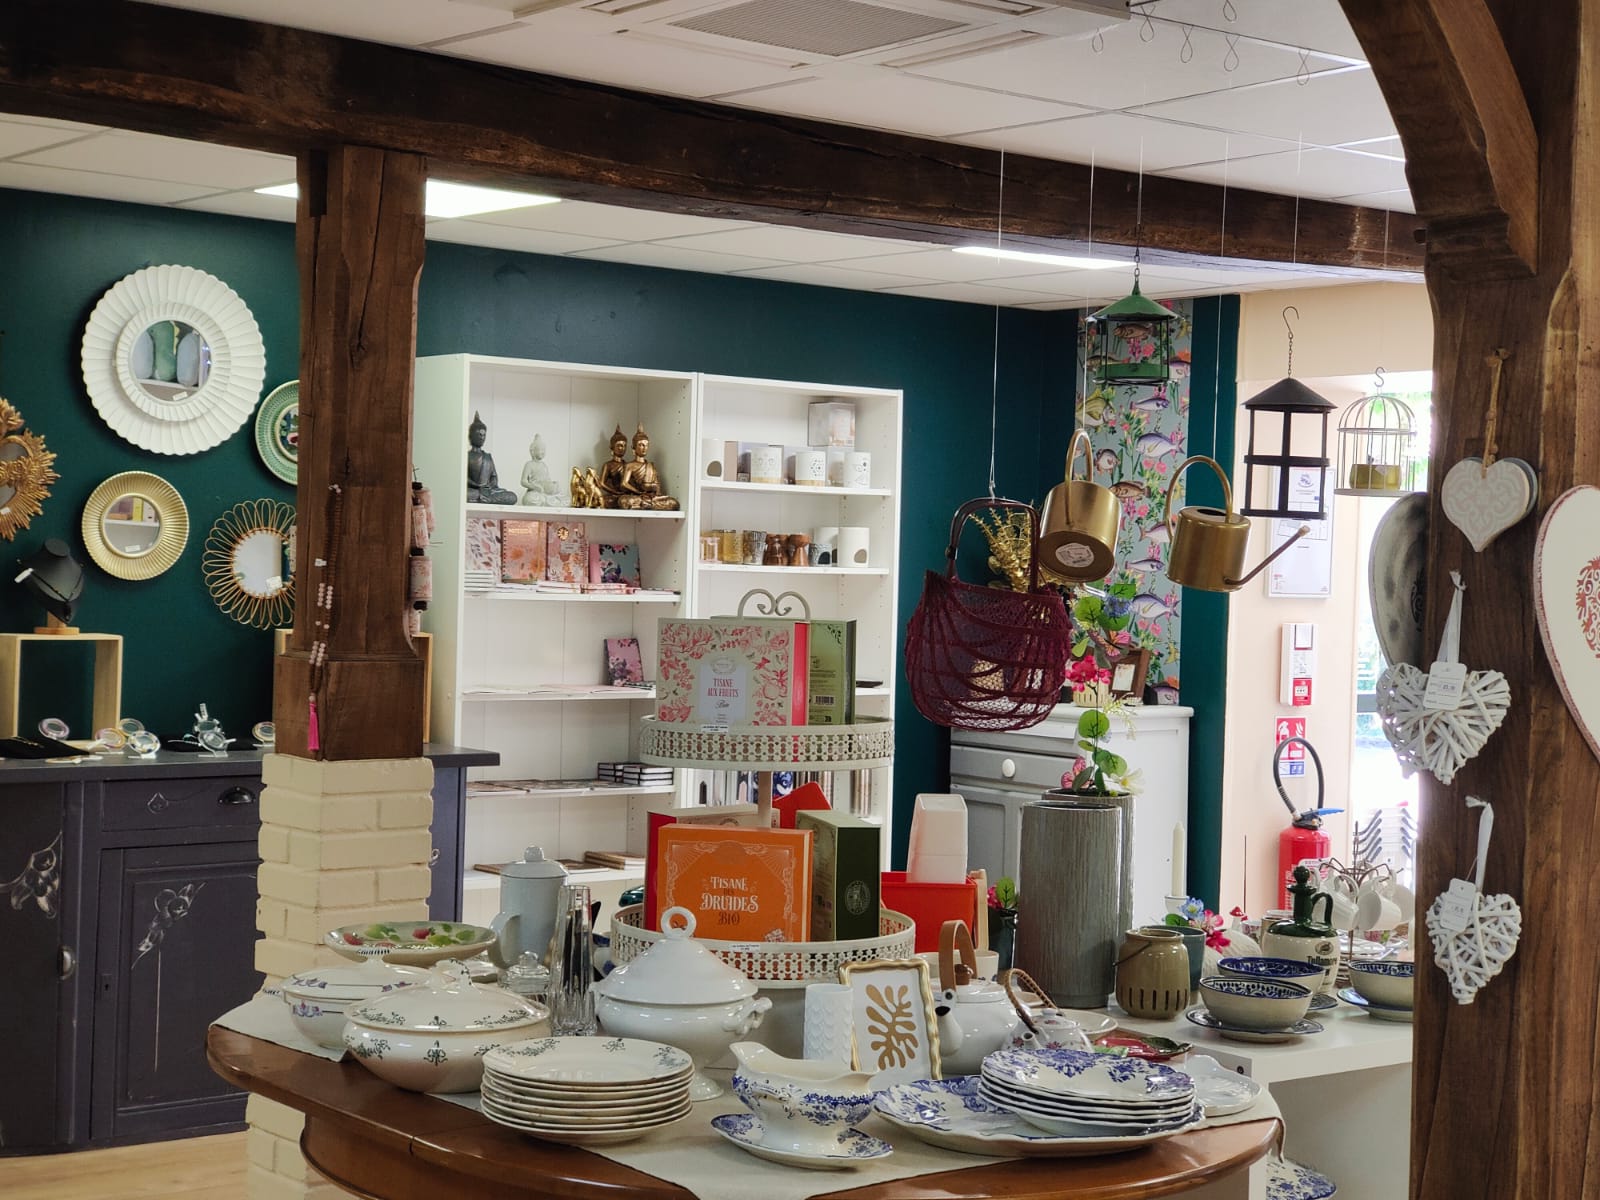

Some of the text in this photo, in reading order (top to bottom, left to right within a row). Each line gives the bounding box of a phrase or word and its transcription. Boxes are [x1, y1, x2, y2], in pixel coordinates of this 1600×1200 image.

[710, 876, 748, 891] TISANE
[700, 892, 759, 913] DRUIDES
[718, 911, 740, 925] BIO
